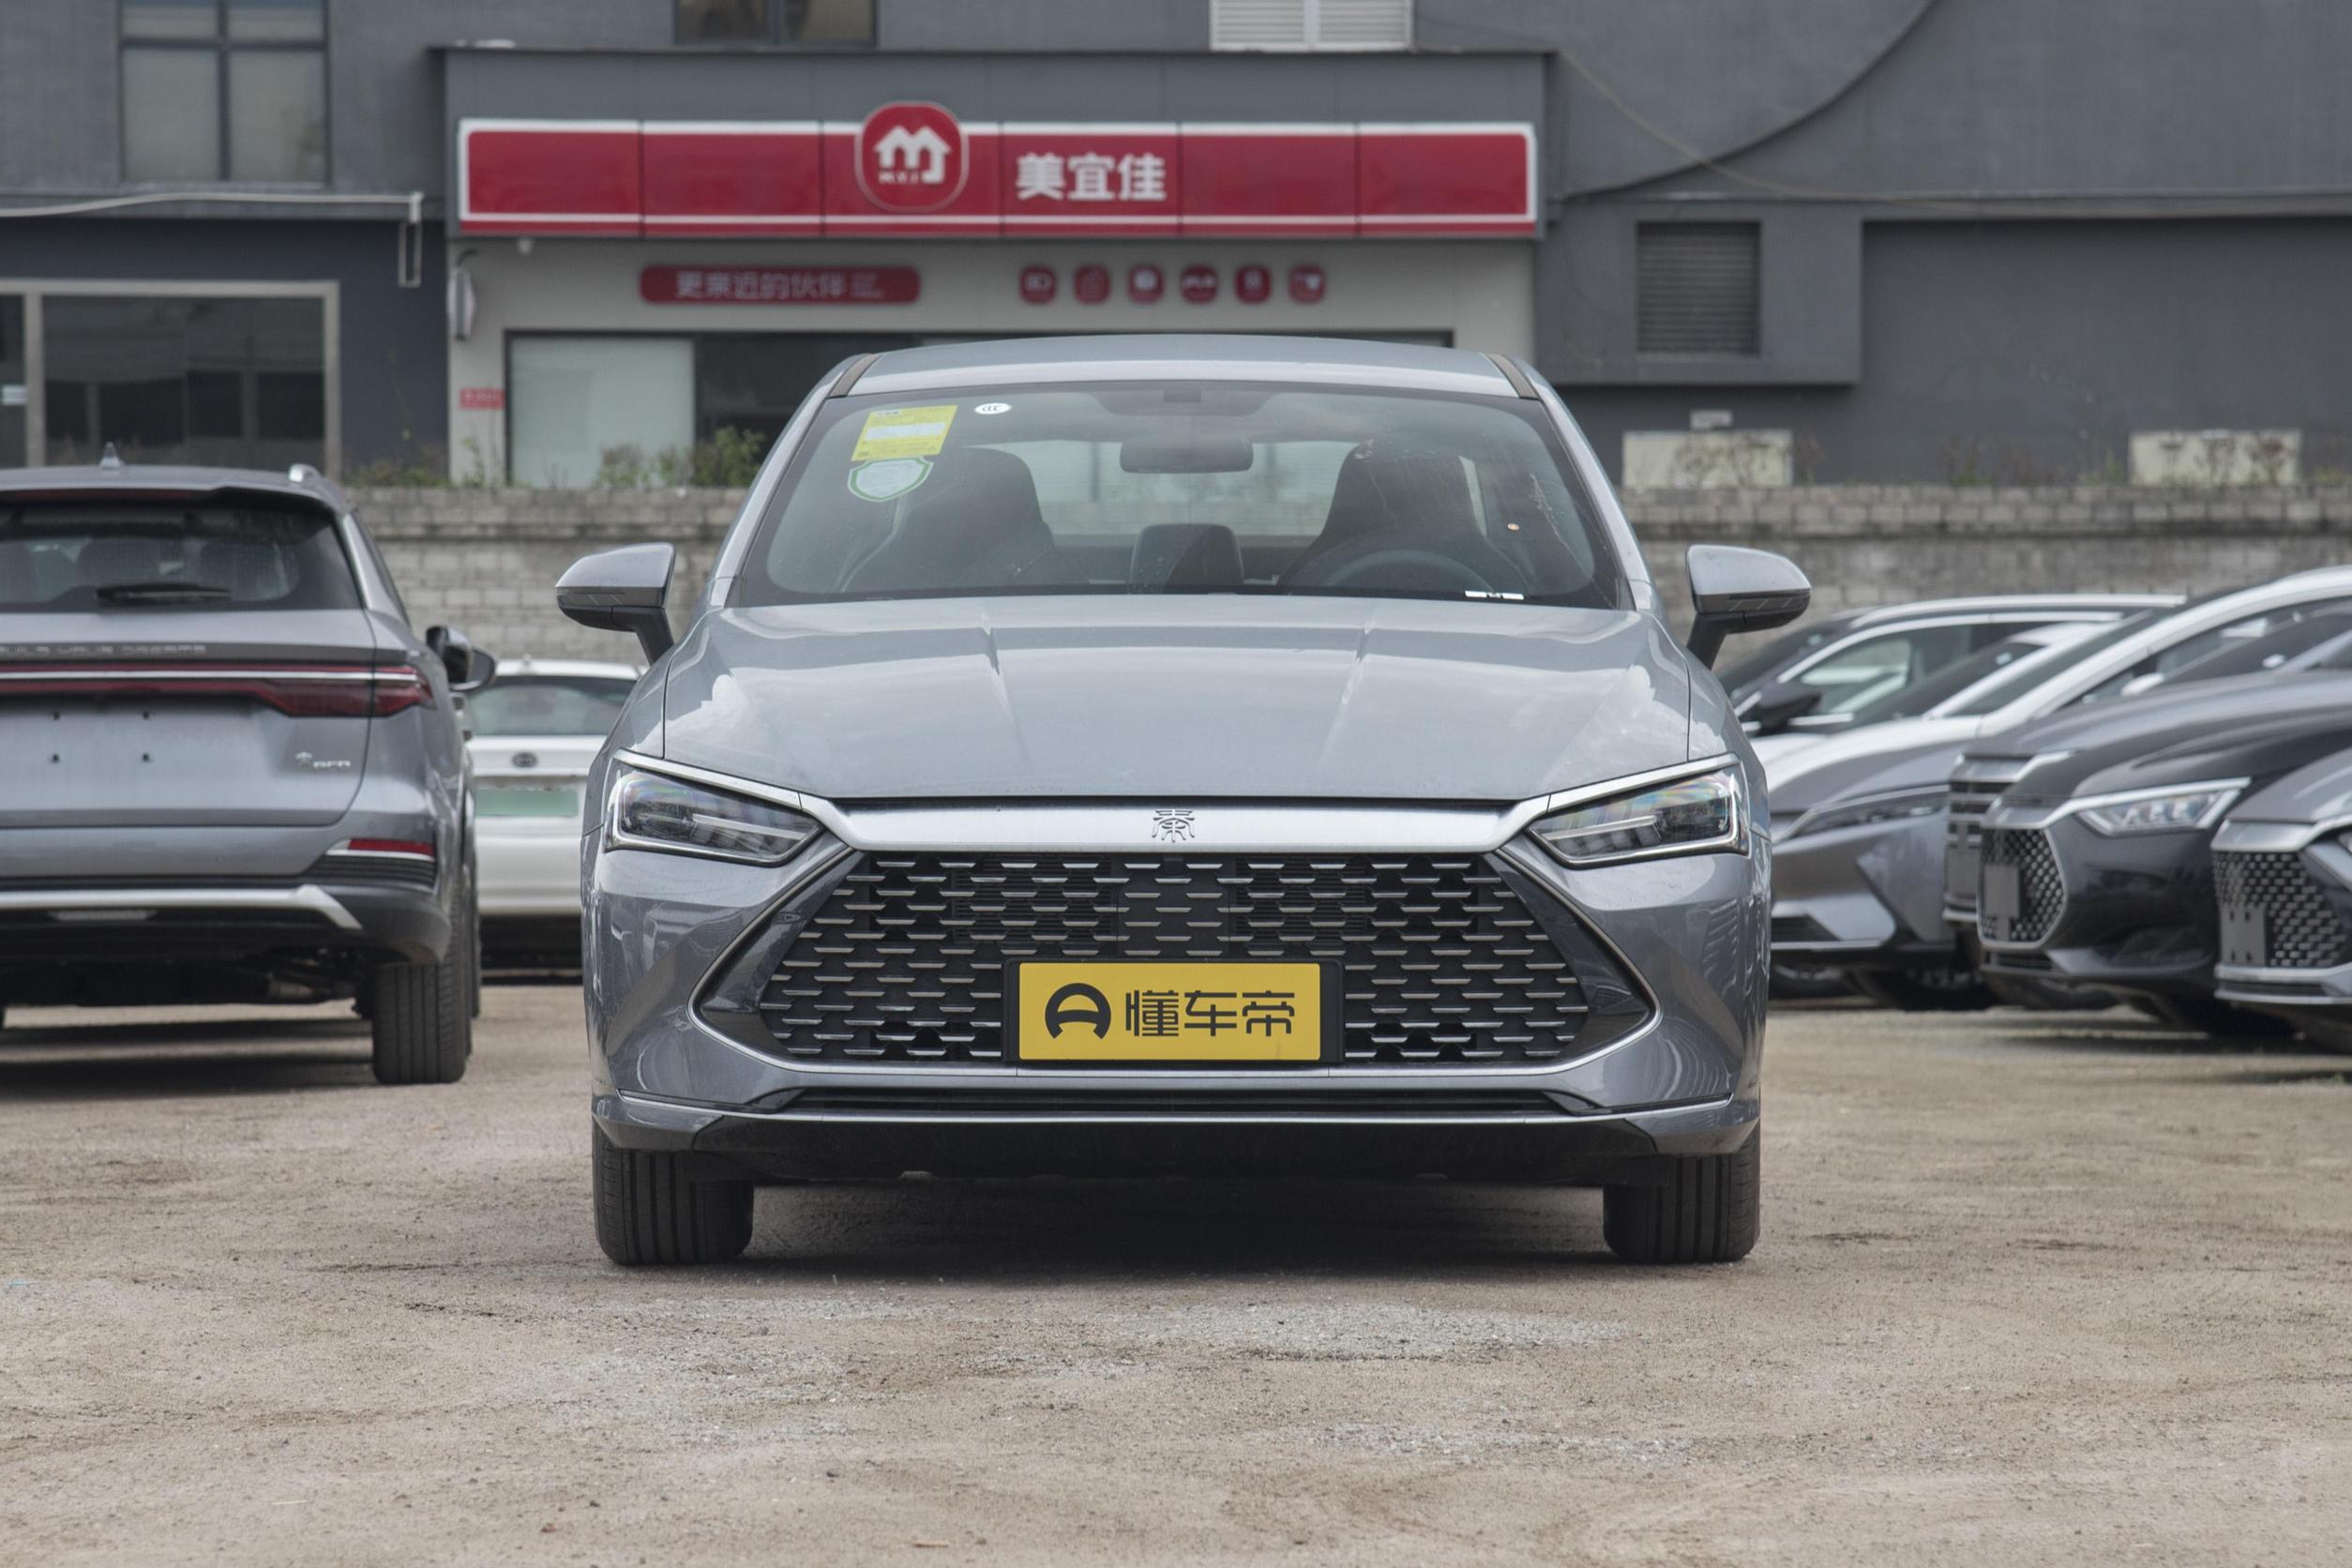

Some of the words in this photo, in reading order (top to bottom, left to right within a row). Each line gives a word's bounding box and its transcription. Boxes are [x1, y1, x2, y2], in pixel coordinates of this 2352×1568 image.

[1016, 152, 1167, 201] 美宜佳
[1125, 989, 1295, 1037] 懂车帝
